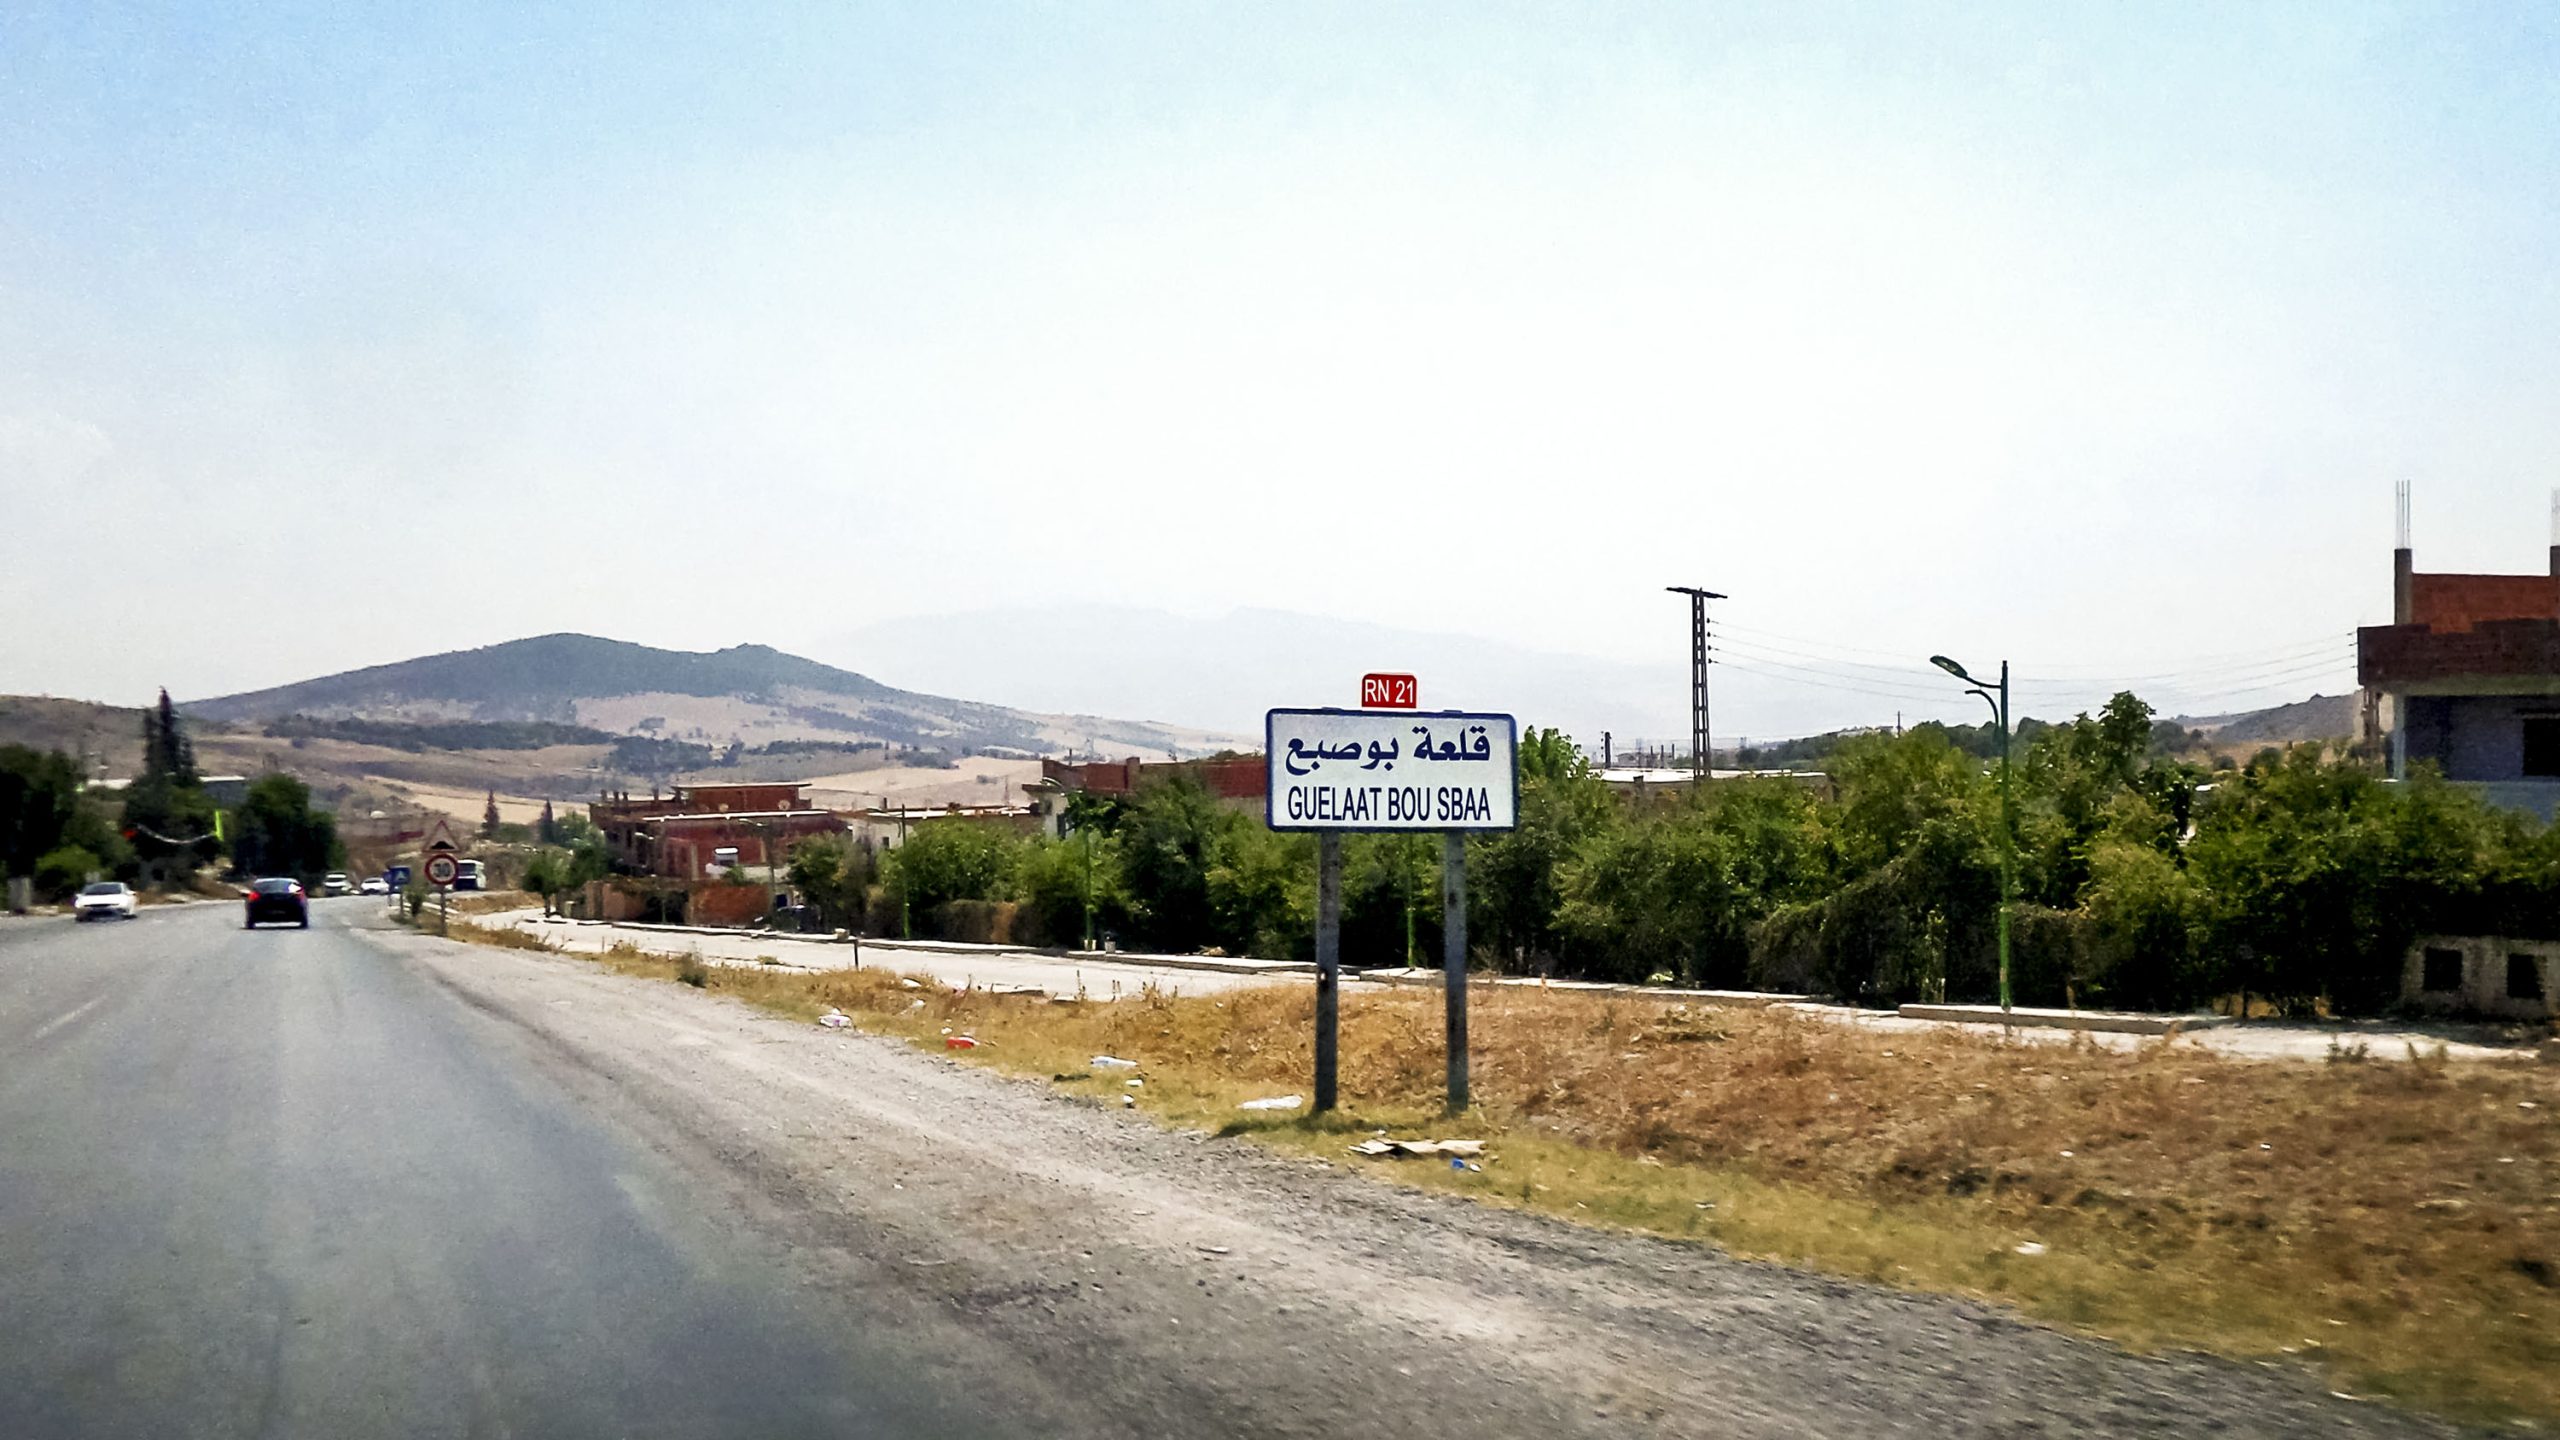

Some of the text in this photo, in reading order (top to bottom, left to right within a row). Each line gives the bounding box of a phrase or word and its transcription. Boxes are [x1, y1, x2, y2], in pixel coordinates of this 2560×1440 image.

[1364, 679, 1414, 703] RN 21
[1286, 726, 1491, 776] قلعة بوصبع
[1287, 786, 1491, 821] GUELAAT BOU SBAA
